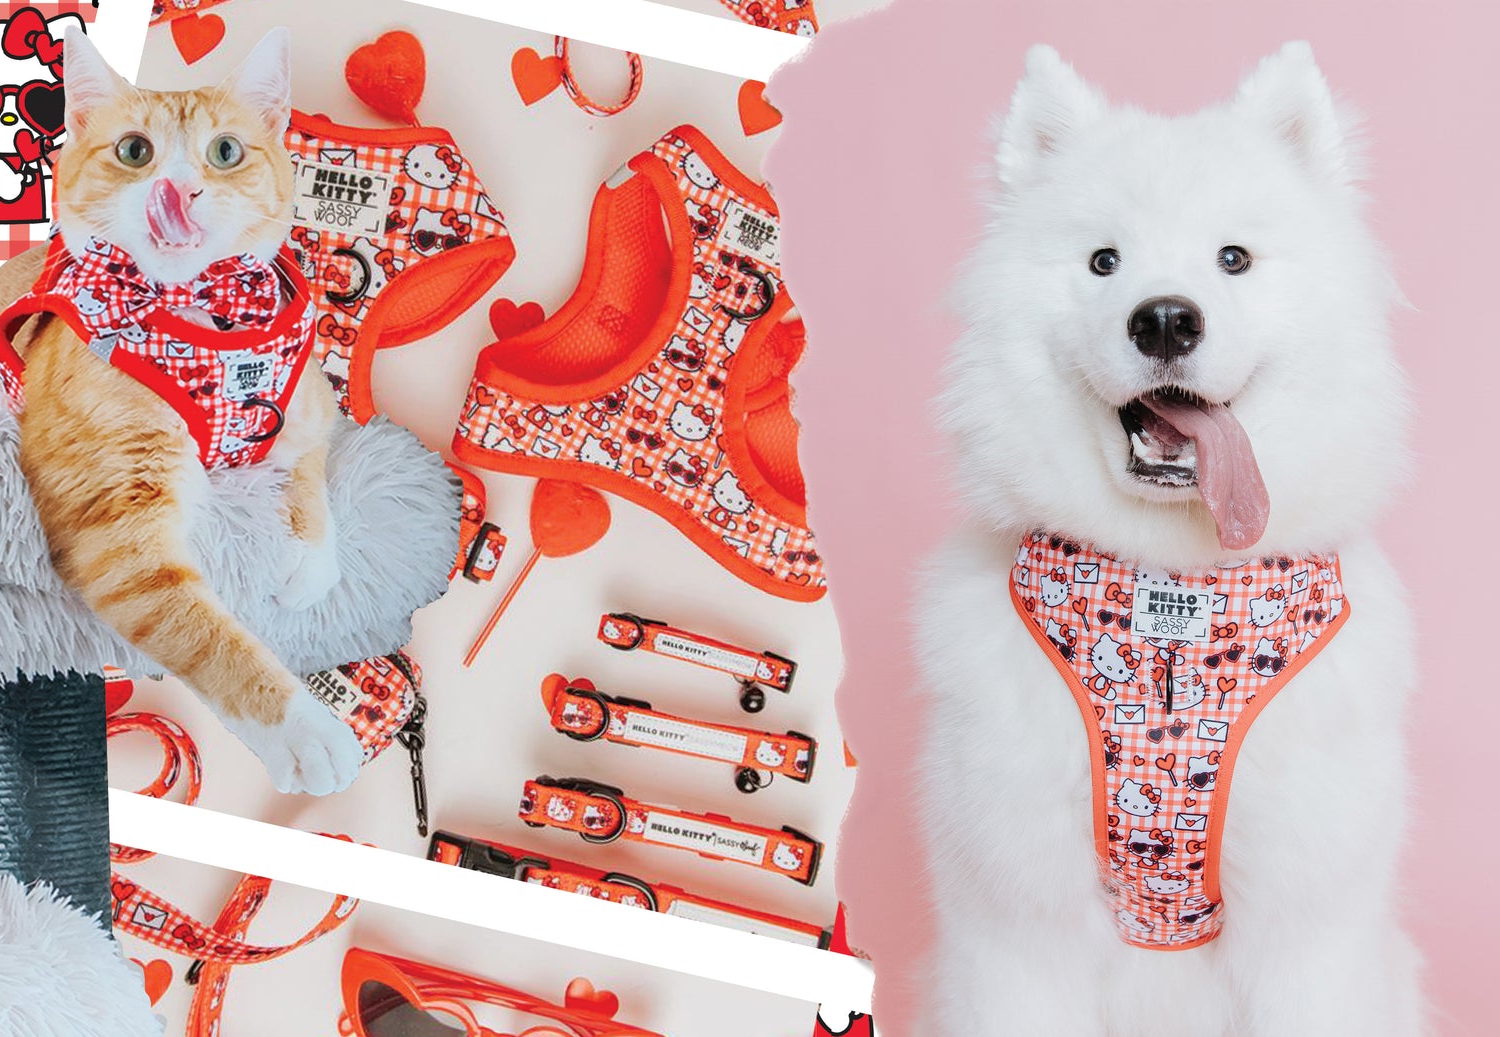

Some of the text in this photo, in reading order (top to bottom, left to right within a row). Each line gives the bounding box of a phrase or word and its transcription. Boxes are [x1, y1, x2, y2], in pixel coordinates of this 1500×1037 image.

[314, 169, 373, 190] HELLO
[312, 182, 373, 205] KITTY
[318, 201, 362, 217] SASSY
[739, 220, 774, 241] KITTY
[742, 213, 775, 233] HELLO
[1148, 590, 1198, 606] HELLO
[1147, 602, 1199, 617] KITTY
[1151, 623, 1188, 635] WOOF
[1153, 616, 1191, 628] SASSY
[661, 639, 708, 657] HELLO KITTY
[317, 670, 348, 696] ELLO
[632, 724, 686, 742] HELLO KITTY
[651, 822, 681, 836] HELLO
[681, 829, 713, 843] KITTY
